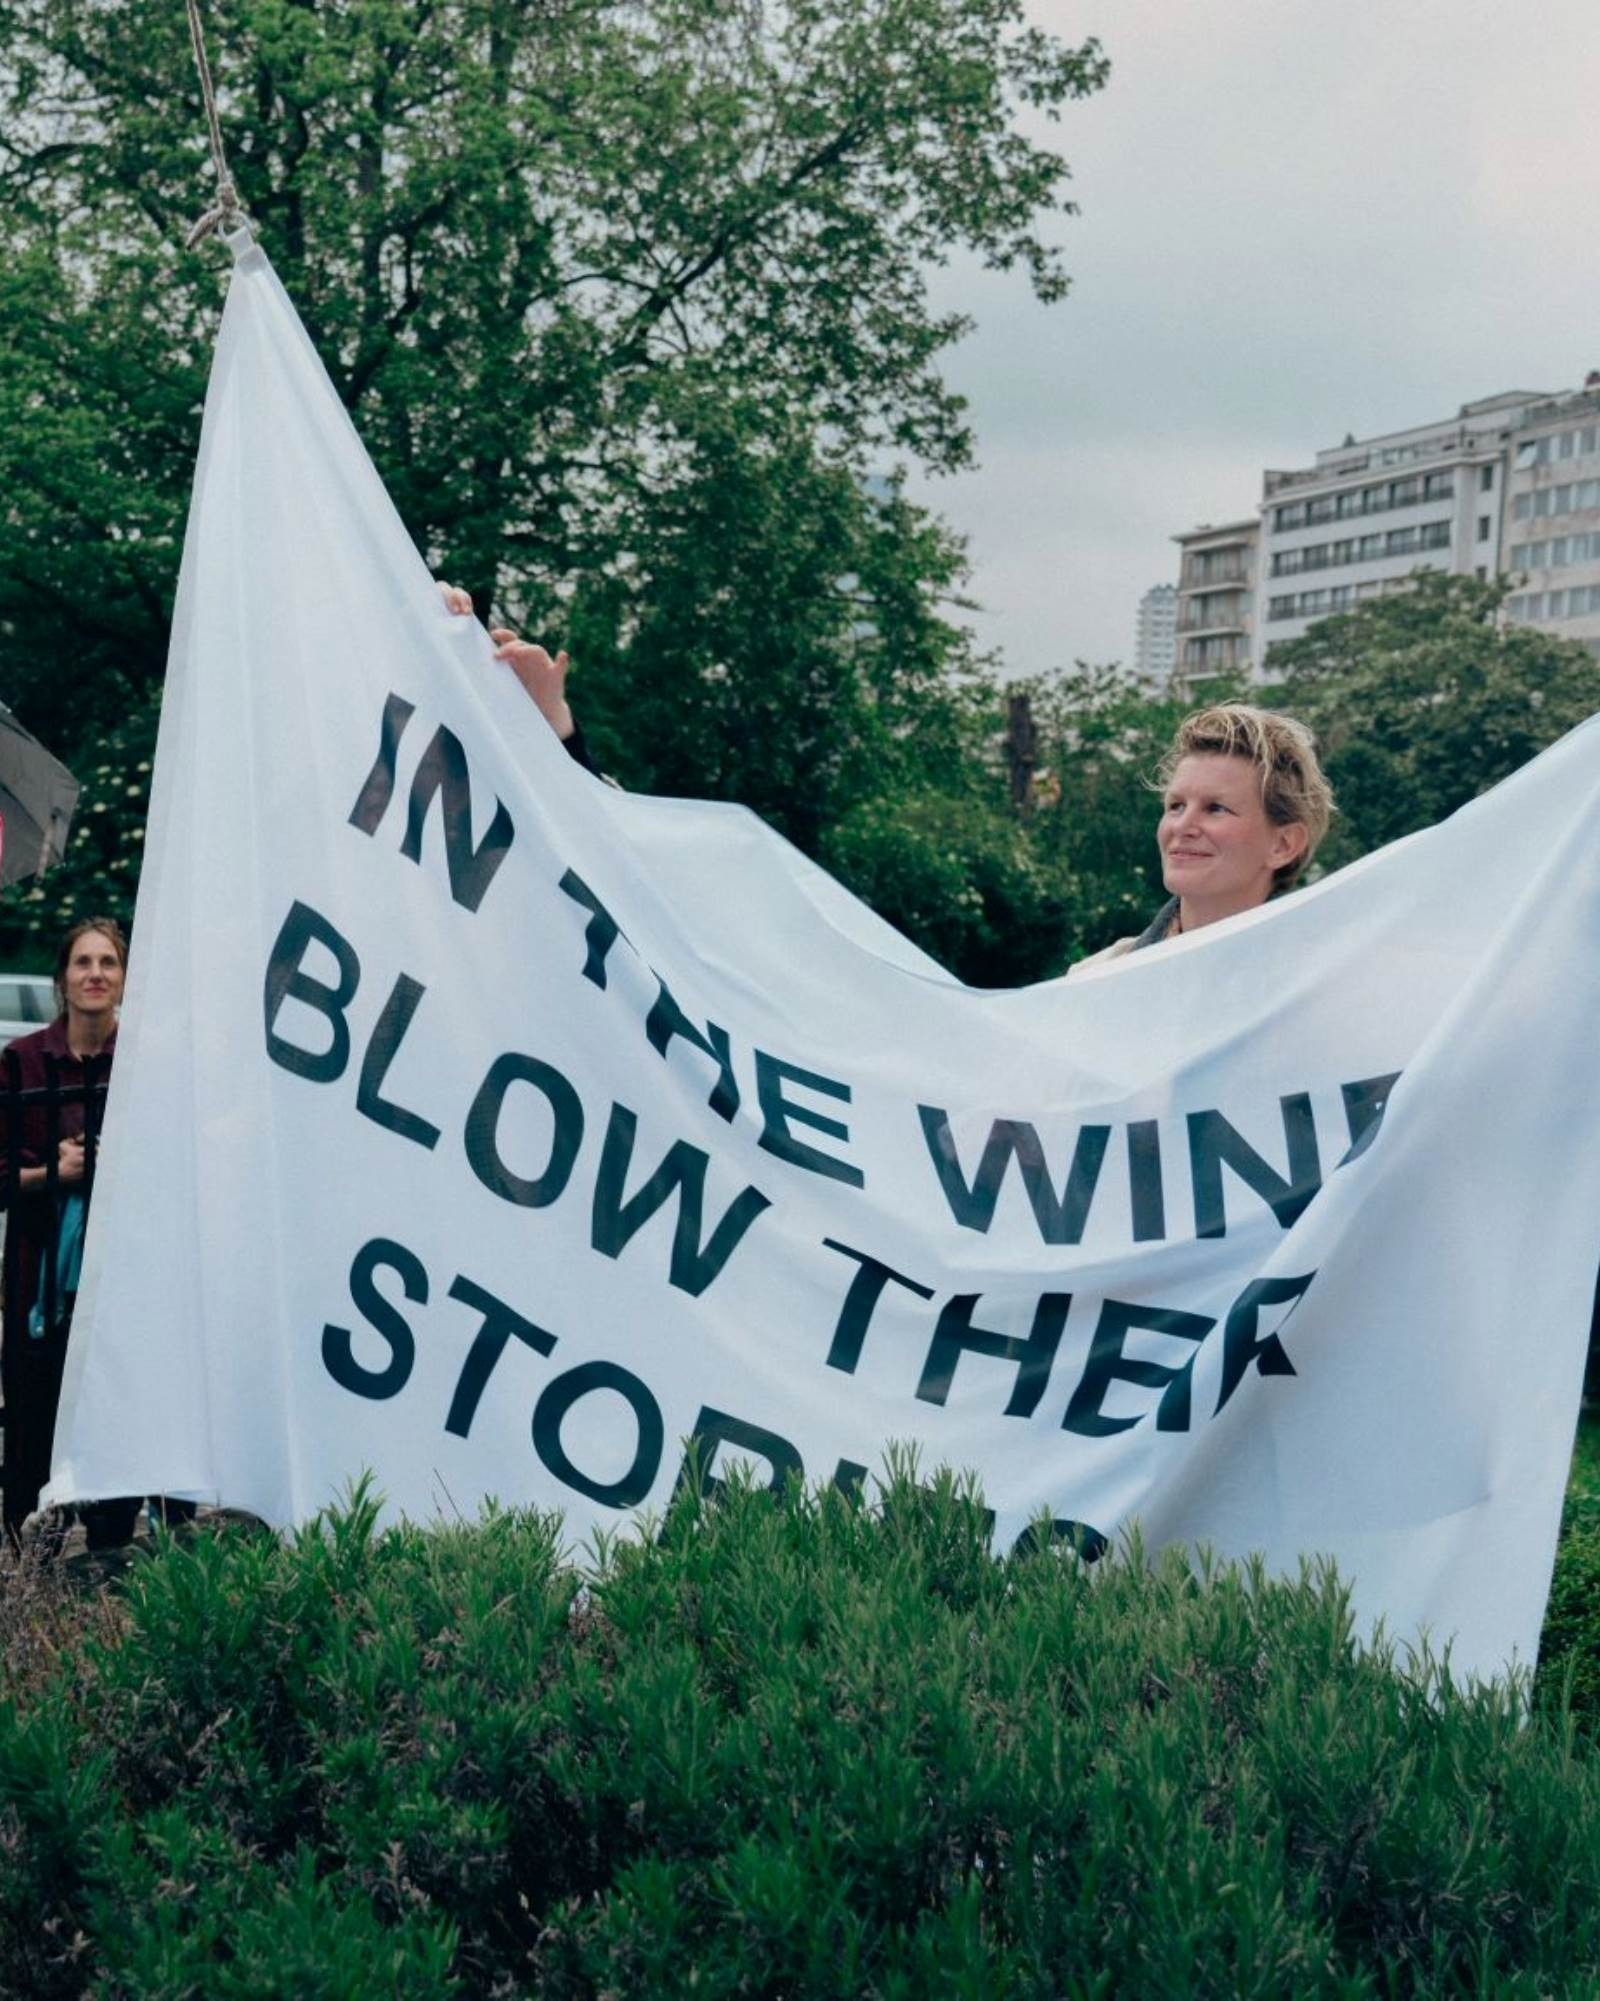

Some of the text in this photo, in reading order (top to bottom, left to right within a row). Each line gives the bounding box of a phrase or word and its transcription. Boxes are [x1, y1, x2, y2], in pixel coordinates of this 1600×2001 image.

[264, 899, 772, 1298] BLOW
[347, 692, 516, 914] IN
[558, 866, 865, 1190] THE
[321, 1237, 1109, 1563] STOR
